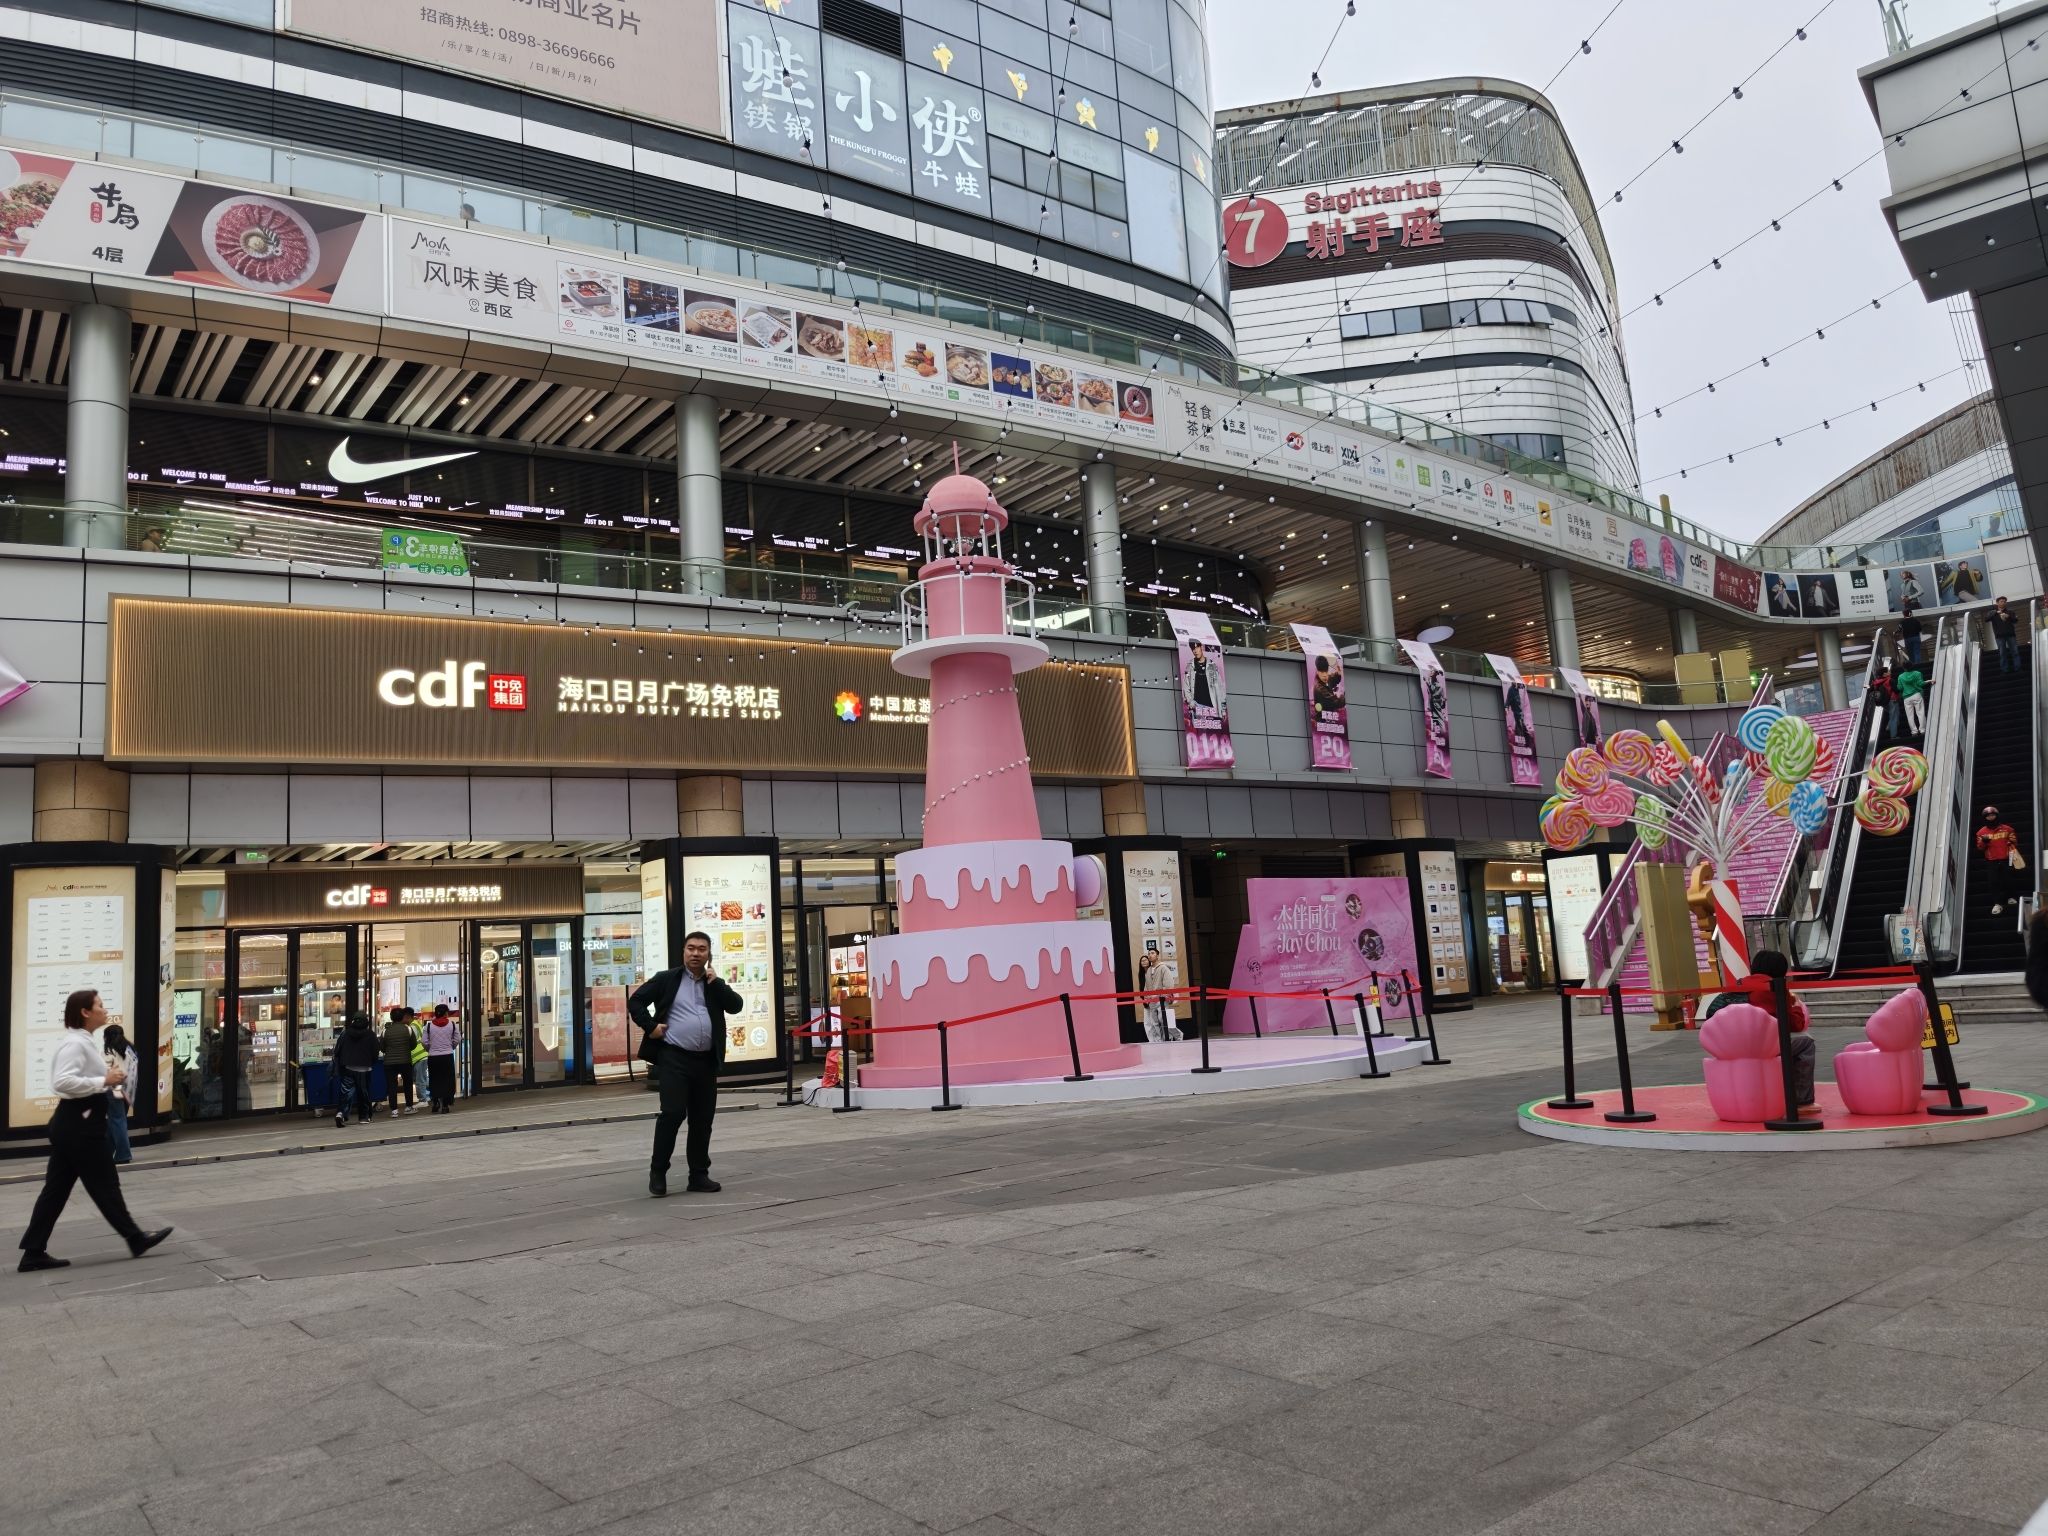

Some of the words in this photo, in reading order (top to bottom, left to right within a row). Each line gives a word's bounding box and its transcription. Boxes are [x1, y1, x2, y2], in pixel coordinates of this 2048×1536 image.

[498, 27, 616, 69] 0898-36696666
[743, 100, 815, 146] 铁锅
[920, 160, 982, 199] 牛蛙
[829, 134, 845, 146] THE
[846, 139, 877, 157] KUNGFU
[877, 150, 907, 165] FROGGY
[1304, 179, 1442, 214] Sagittarius
[1234, 209, 1265, 254] 7
[1305, 206, 1445, 260] 射手座
[91, 247, 124, 263] 4层
[424, 260, 538, 303] 风味美食
[483, 302, 514, 319] 西区
[1184, 400, 1212, 421] 轻食
[6, 455, 56, 466] MEMBERSHIP
[161, 468, 196, 478] WELCOME
[209, 473, 226, 481] NIKE
[225, 482, 270, 492] MEMBERSHIP
[366, 497, 397, 506] WELCOME
[409, 501, 424, 509] NIKE
[408, 494, 422, 502] JUST
[506, 504, 544, 514] MEMBERSHIP
[622, 515, 649, 524] WELCOME
[659, 518, 671, 526] NIKE
[378, 660, 486, 708] cdf
[493, 679, 523, 693] 中免
[558, 676, 781, 709] 海口日月广场免税店
[493, 692, 523, 706] 集团
[557, 702, 626, 714] HAIKOU
[637, 705, 680, 717] DUTY
[691, 707, 730, 718] FREE
[740, 710, 783, 720] SHOP
[869, 713, 902, 723] Member
[904, 714, 914, 723] of
[1185, 732, 1234, 761] 0118
[1320, 735, 1344, 758] 20
[1516, 757, 1532, 777] 20
[326, 885, 371, 907] cdf
[401, 886, 502, 900] 海口日月广场免税店
[1277, 932, 1303, 954] Jay
[1305, 932, 1342, 953] Chou
[405, 963, 447, 973] CLINIQUE
